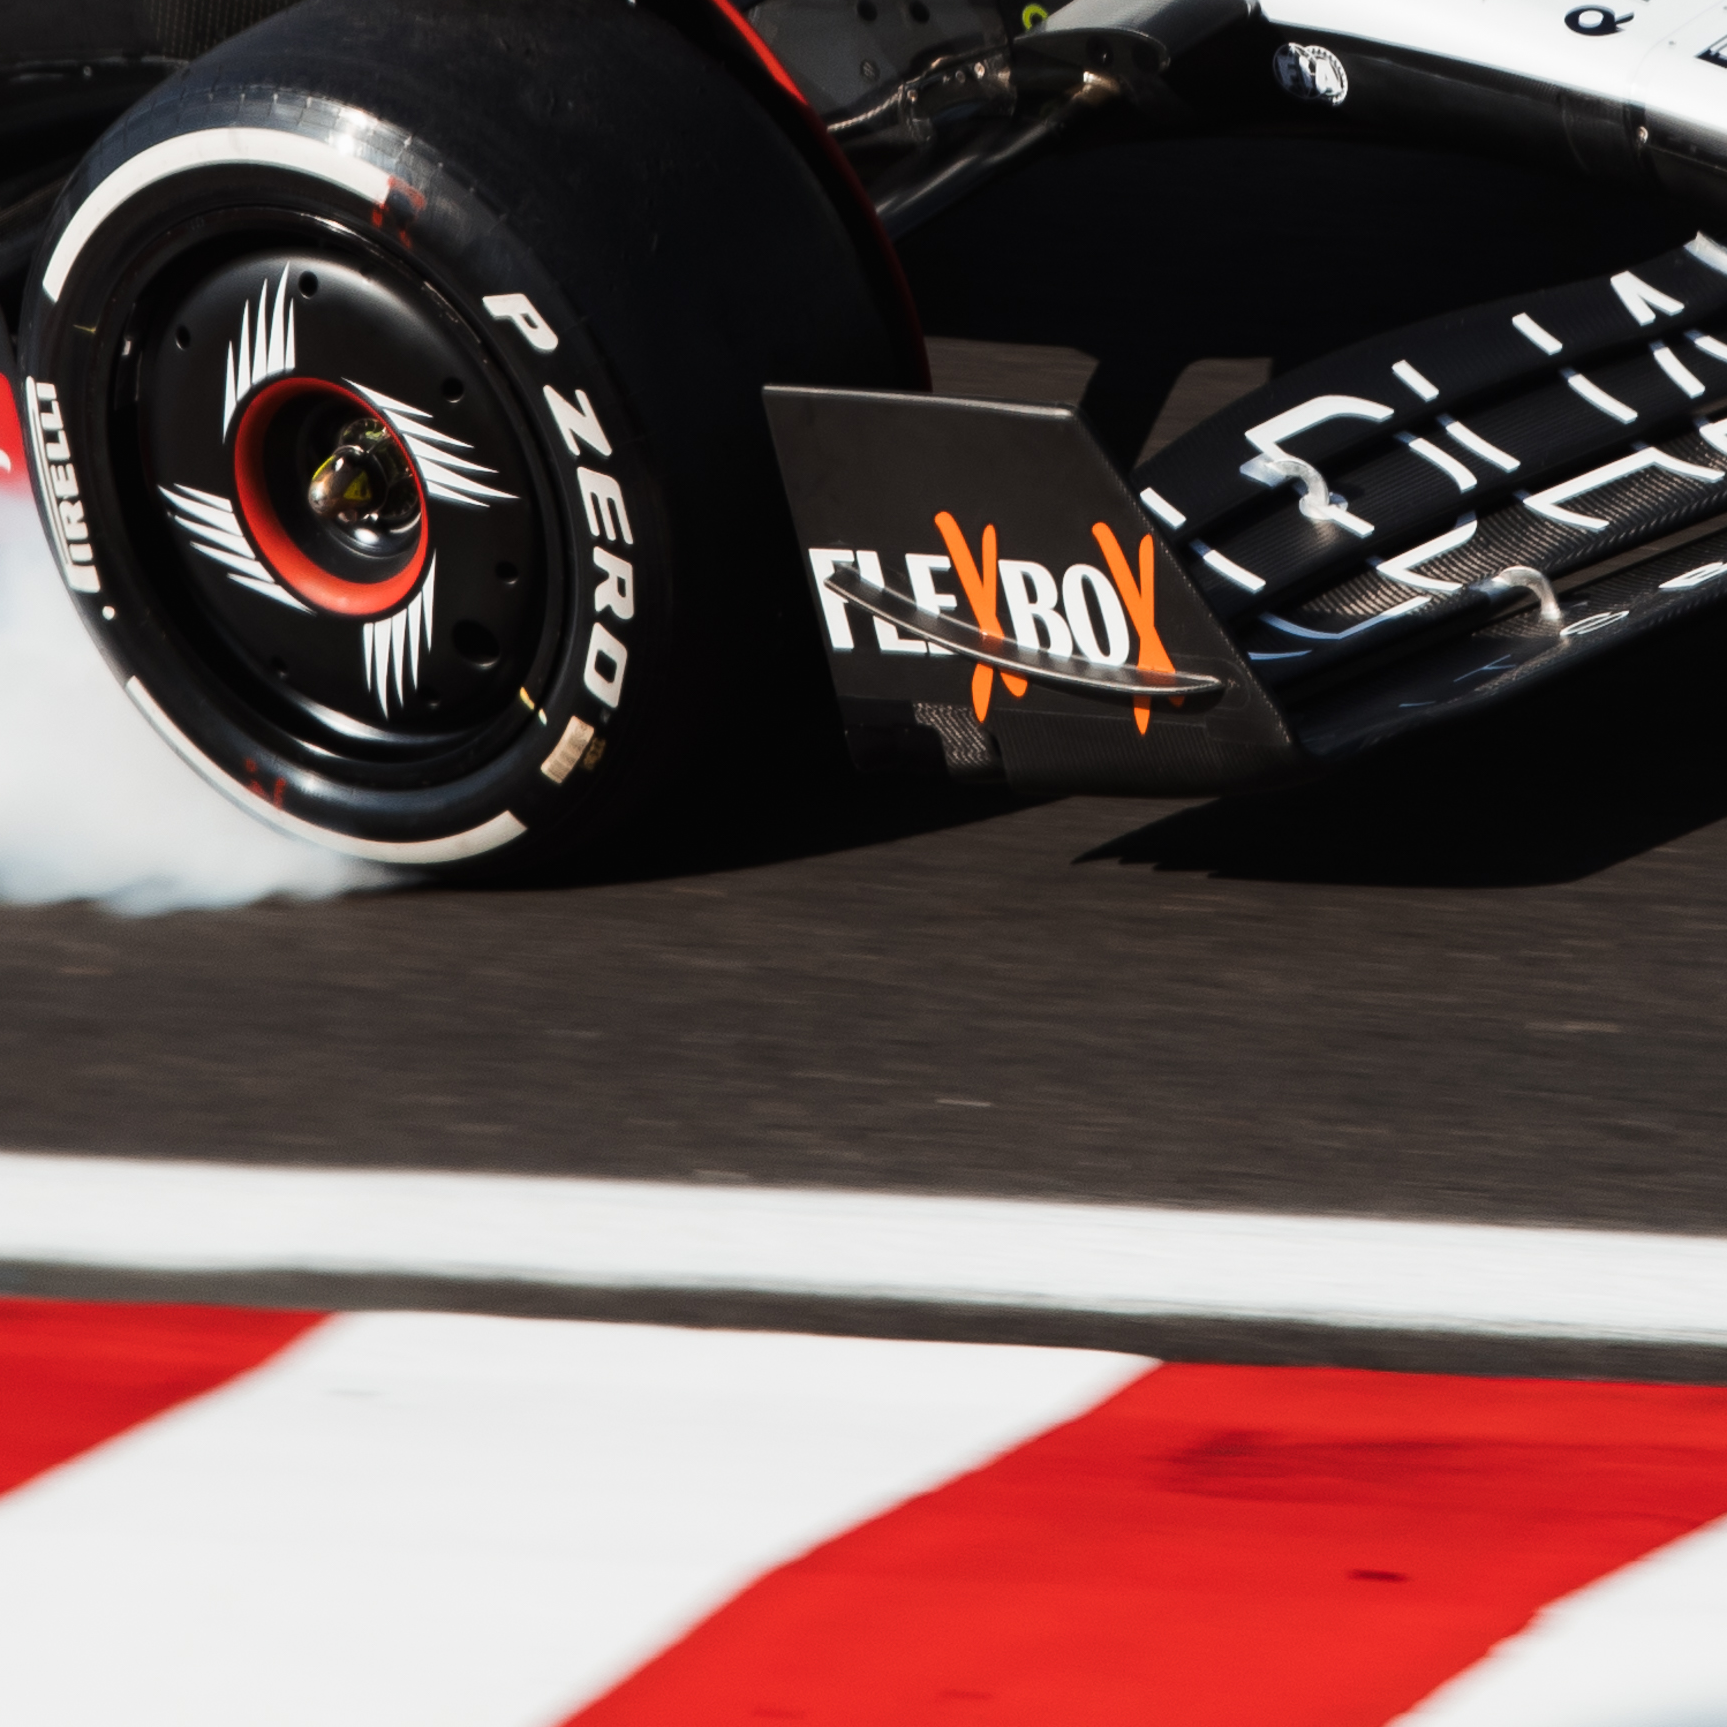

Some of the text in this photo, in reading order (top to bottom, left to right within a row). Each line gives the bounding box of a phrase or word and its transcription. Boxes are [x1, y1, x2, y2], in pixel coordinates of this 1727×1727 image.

[24, 374, 103, 595] PIRELLI
[482, 291, 637, 711] P ZERO
[807, 510, 1178, 737] FLEXBOX
